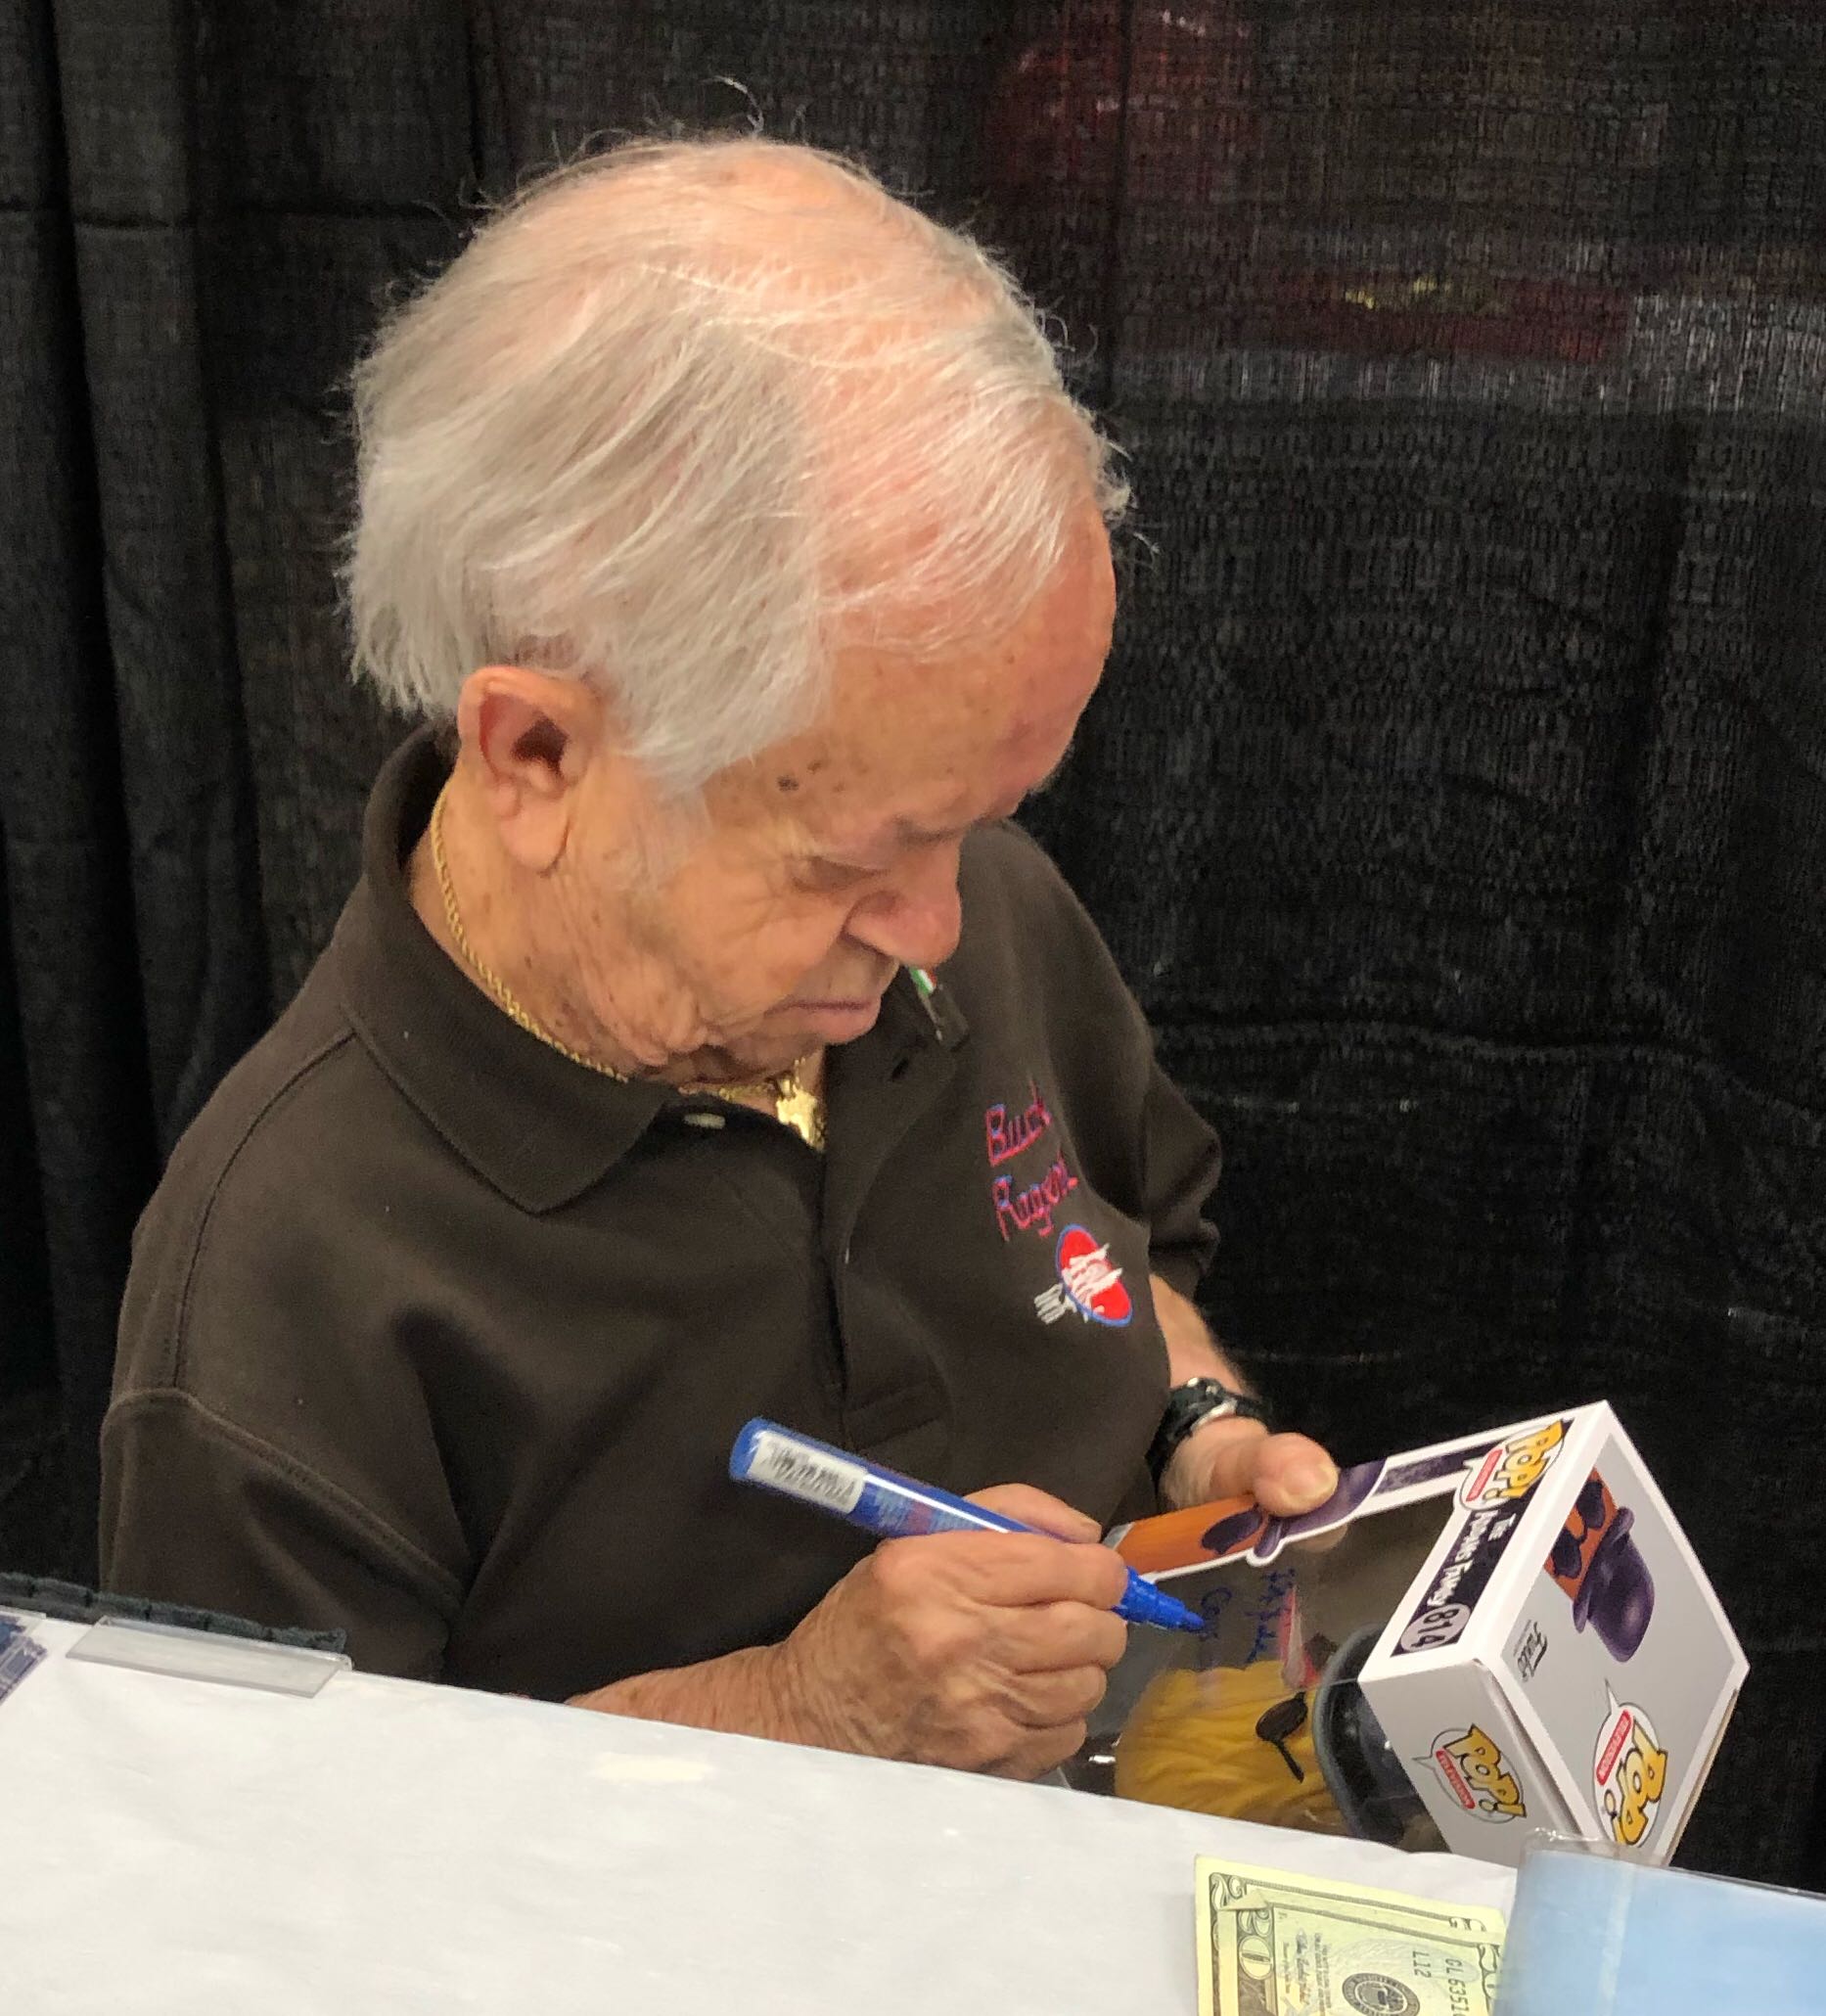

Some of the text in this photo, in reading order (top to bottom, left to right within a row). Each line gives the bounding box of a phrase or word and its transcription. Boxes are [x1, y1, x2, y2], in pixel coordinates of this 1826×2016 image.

[1410, 1608, 1460, 1648] 814
[1442, 1722, 1528, 1818] POP!
[1412, 1949, 1432, 1978] L12
